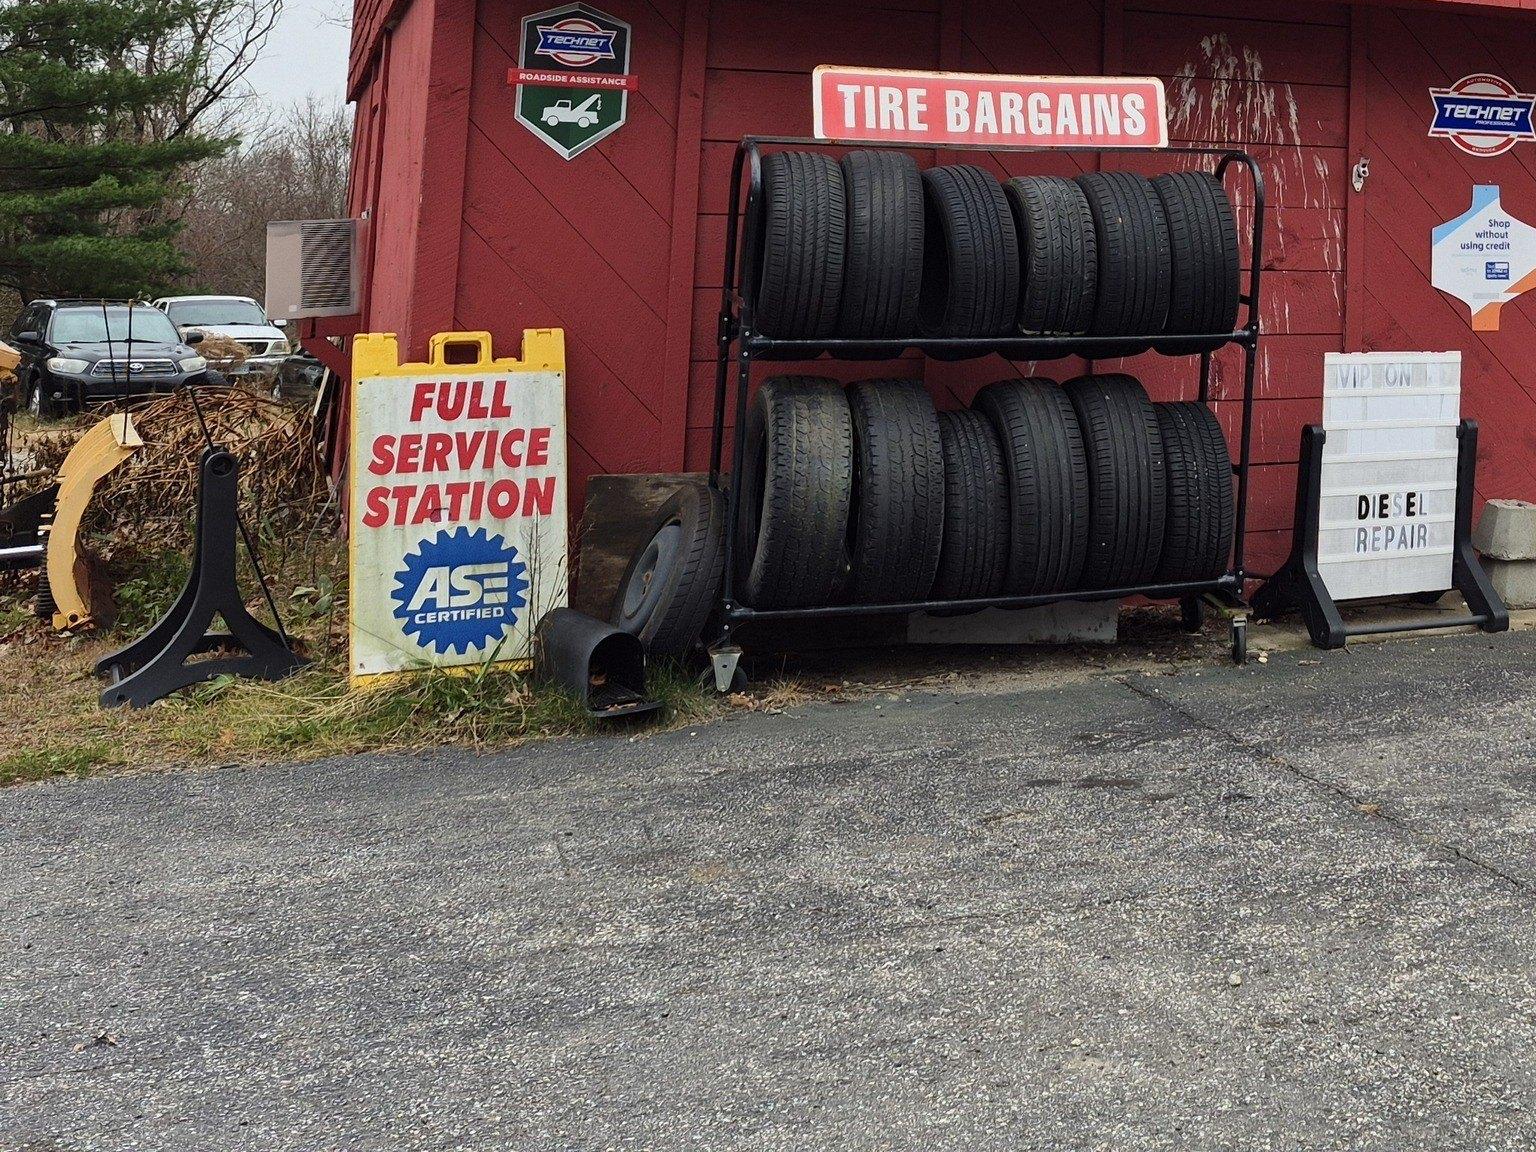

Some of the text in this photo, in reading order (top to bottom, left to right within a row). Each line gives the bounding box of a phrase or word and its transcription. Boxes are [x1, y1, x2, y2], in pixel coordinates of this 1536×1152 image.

[519, 72, 627, 86] ROADSIDE ASSISTANCE
[837, 84, 1146, 136] TIRE BARGAINS
[1475, 230, 1509, 239] without
[1488, 219, 1511, 229] Shop
[1460, 242, 1511, 251] using credit
[410, 380, 512, 422] FULL
[368, 427, 552, 476] SERVICE
[362, 476, 557, 528] STATION
[1356, 491, 1428, 521] DIESEL
[1356, 524, 1428, 554] REPAIR
[406, 561, 509, 611] ASE
[414, 606, 505, 625] CERTIFIED
